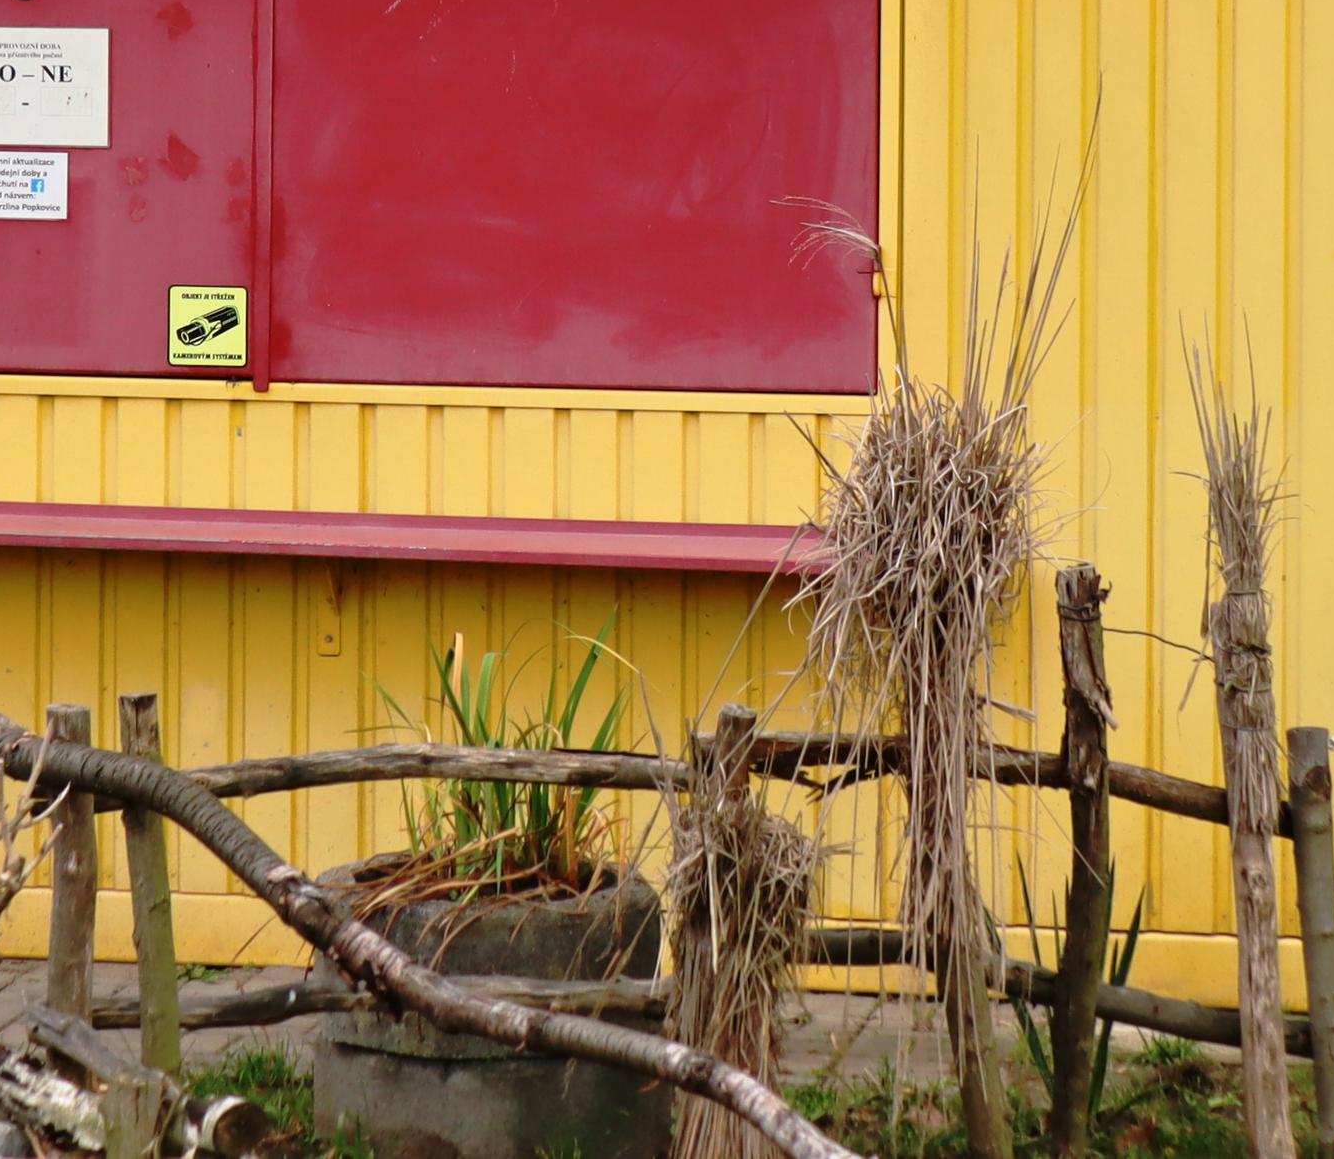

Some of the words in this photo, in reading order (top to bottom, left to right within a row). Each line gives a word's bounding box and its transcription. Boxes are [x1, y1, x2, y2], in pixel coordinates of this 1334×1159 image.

[0, 42, 39, 50] PROVOZNÍ
[41, 65, 73, 83] NE
[12, 157, 55, 166] aktualizace
[21, 169, 41, 178] doby
[21, 203, 61, 212] Popkovice
